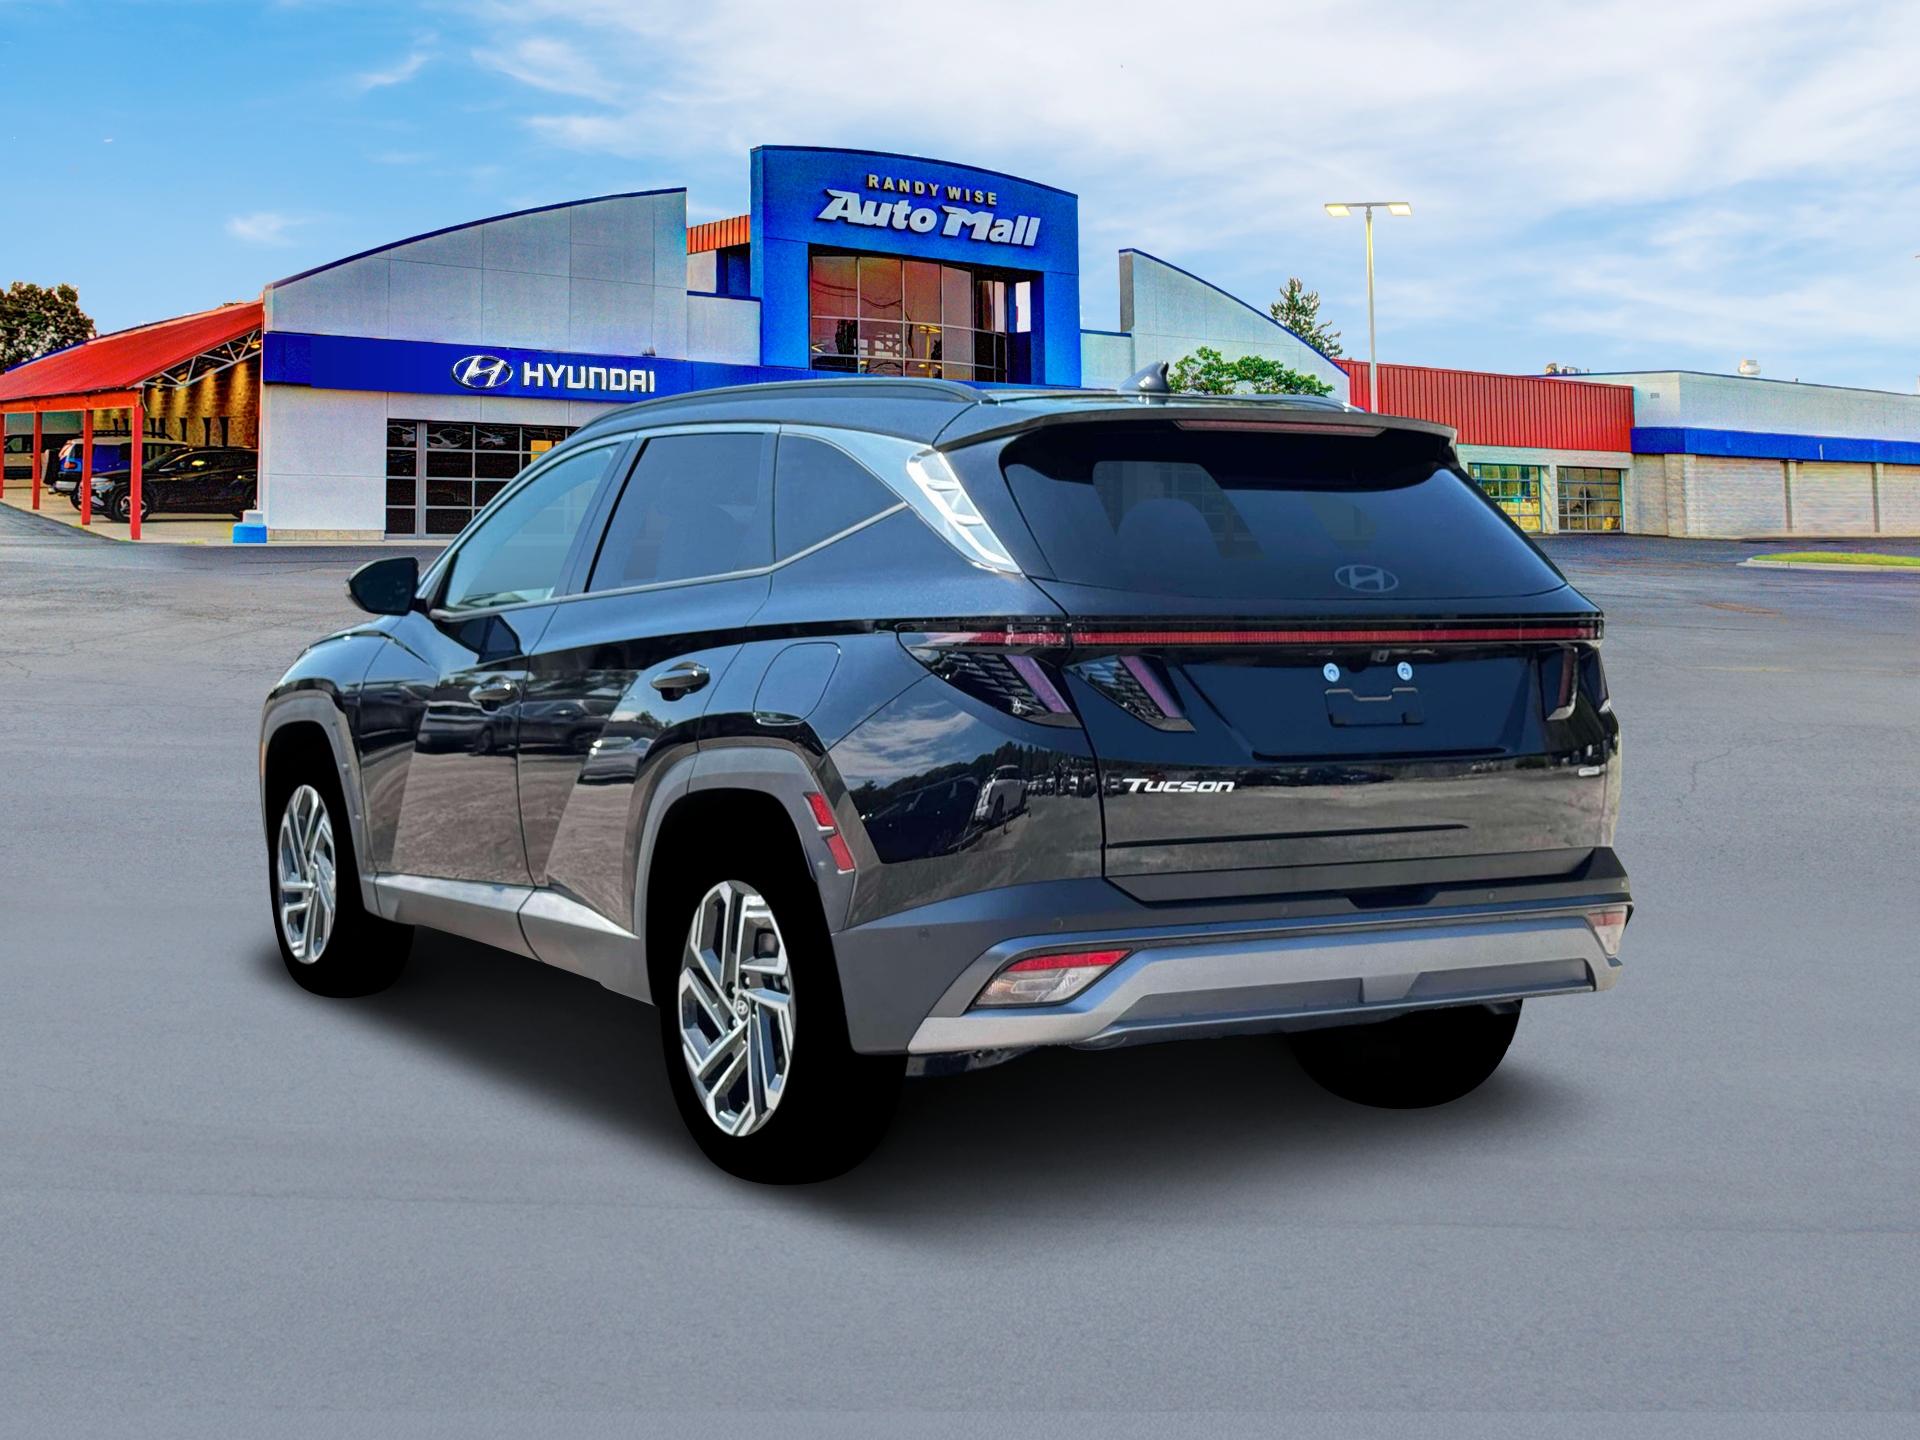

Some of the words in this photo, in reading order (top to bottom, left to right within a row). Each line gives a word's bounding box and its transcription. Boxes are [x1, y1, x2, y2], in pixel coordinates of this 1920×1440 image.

[866, 173, 939, 198] RANDY
[946, 186, 998, 206] WISE
[816, 188, 938, 234] Auto
[941, 205, 1041, 247] Mall
[522, 361, 655, 393] HYUNDAI
